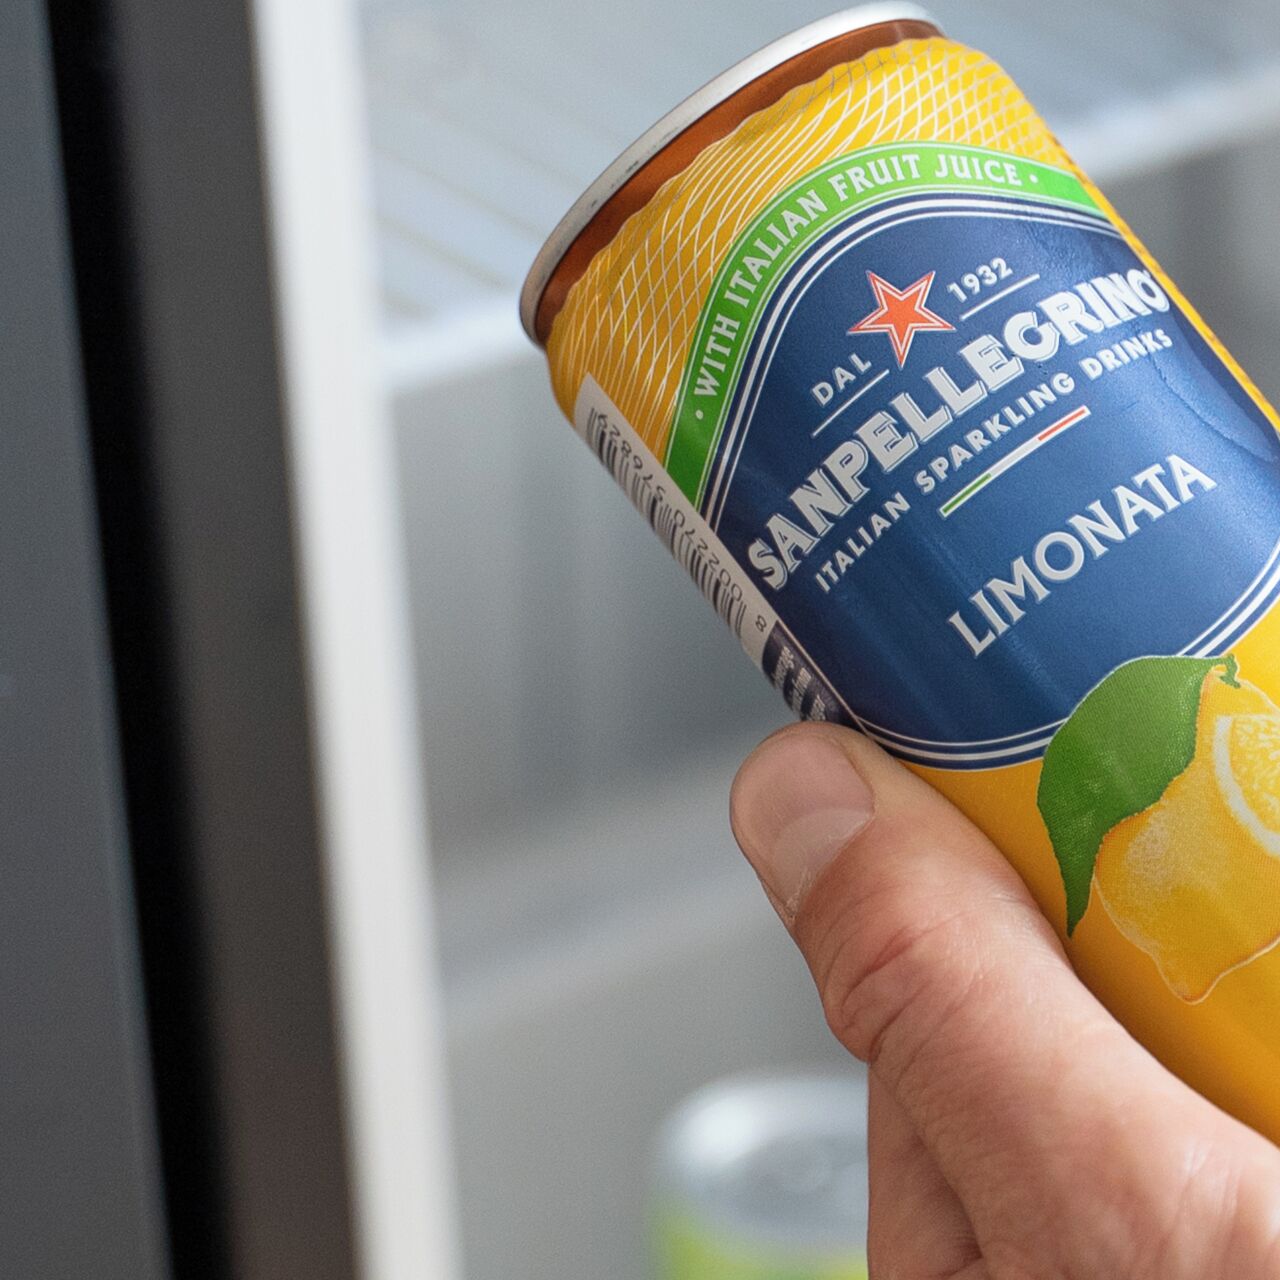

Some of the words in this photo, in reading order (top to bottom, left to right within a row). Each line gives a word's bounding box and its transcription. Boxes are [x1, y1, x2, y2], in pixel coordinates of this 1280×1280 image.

[694, 312, 741, 400] WITH
[724, 189, 829, 308] ITALIAN
[827, 154, 921, 202] FRUIT
[934, 153, 1023, 187] JUICE
[811, 353, 872, 408] DAL
[947, 257, 1013, 303] 1932
[747, 268, 1171, 591] SANPELLEGRINO
[813, 491, 911, 593] ITALIAN
[914, 372, 1076, 494] SPARKLING
[1078, 328, 1174, 381] DRINKS
[947, 453, 1218, 658] LIMONATA
